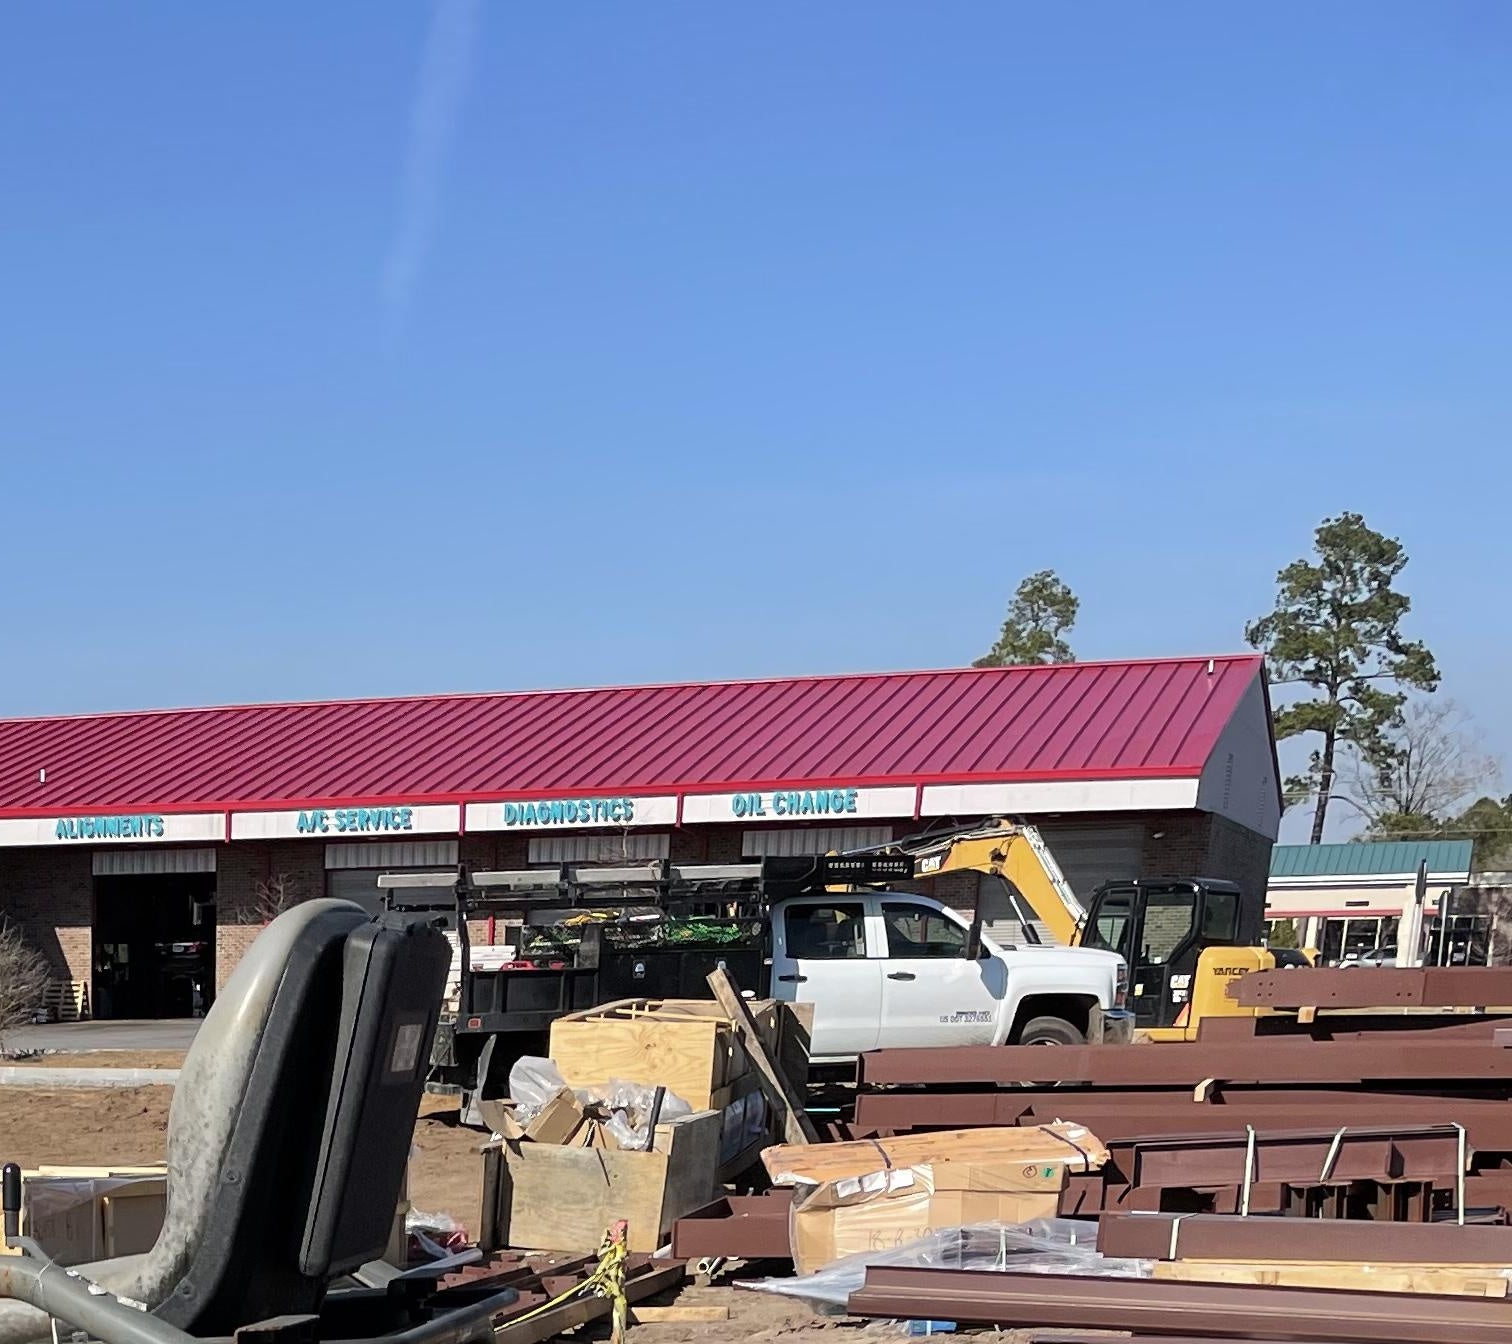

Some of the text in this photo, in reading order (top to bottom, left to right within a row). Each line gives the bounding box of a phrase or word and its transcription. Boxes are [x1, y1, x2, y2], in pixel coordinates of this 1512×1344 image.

[504, 799, 634, 826] DIAGNOSTICS
[732, 789, 859, 817] OIL CHANGE
[55, 815, 165, 840] ALIGNMENTS
[296, 807, 413, 833] A/C SERVICE
[921, 855, 942, 873] CAT
